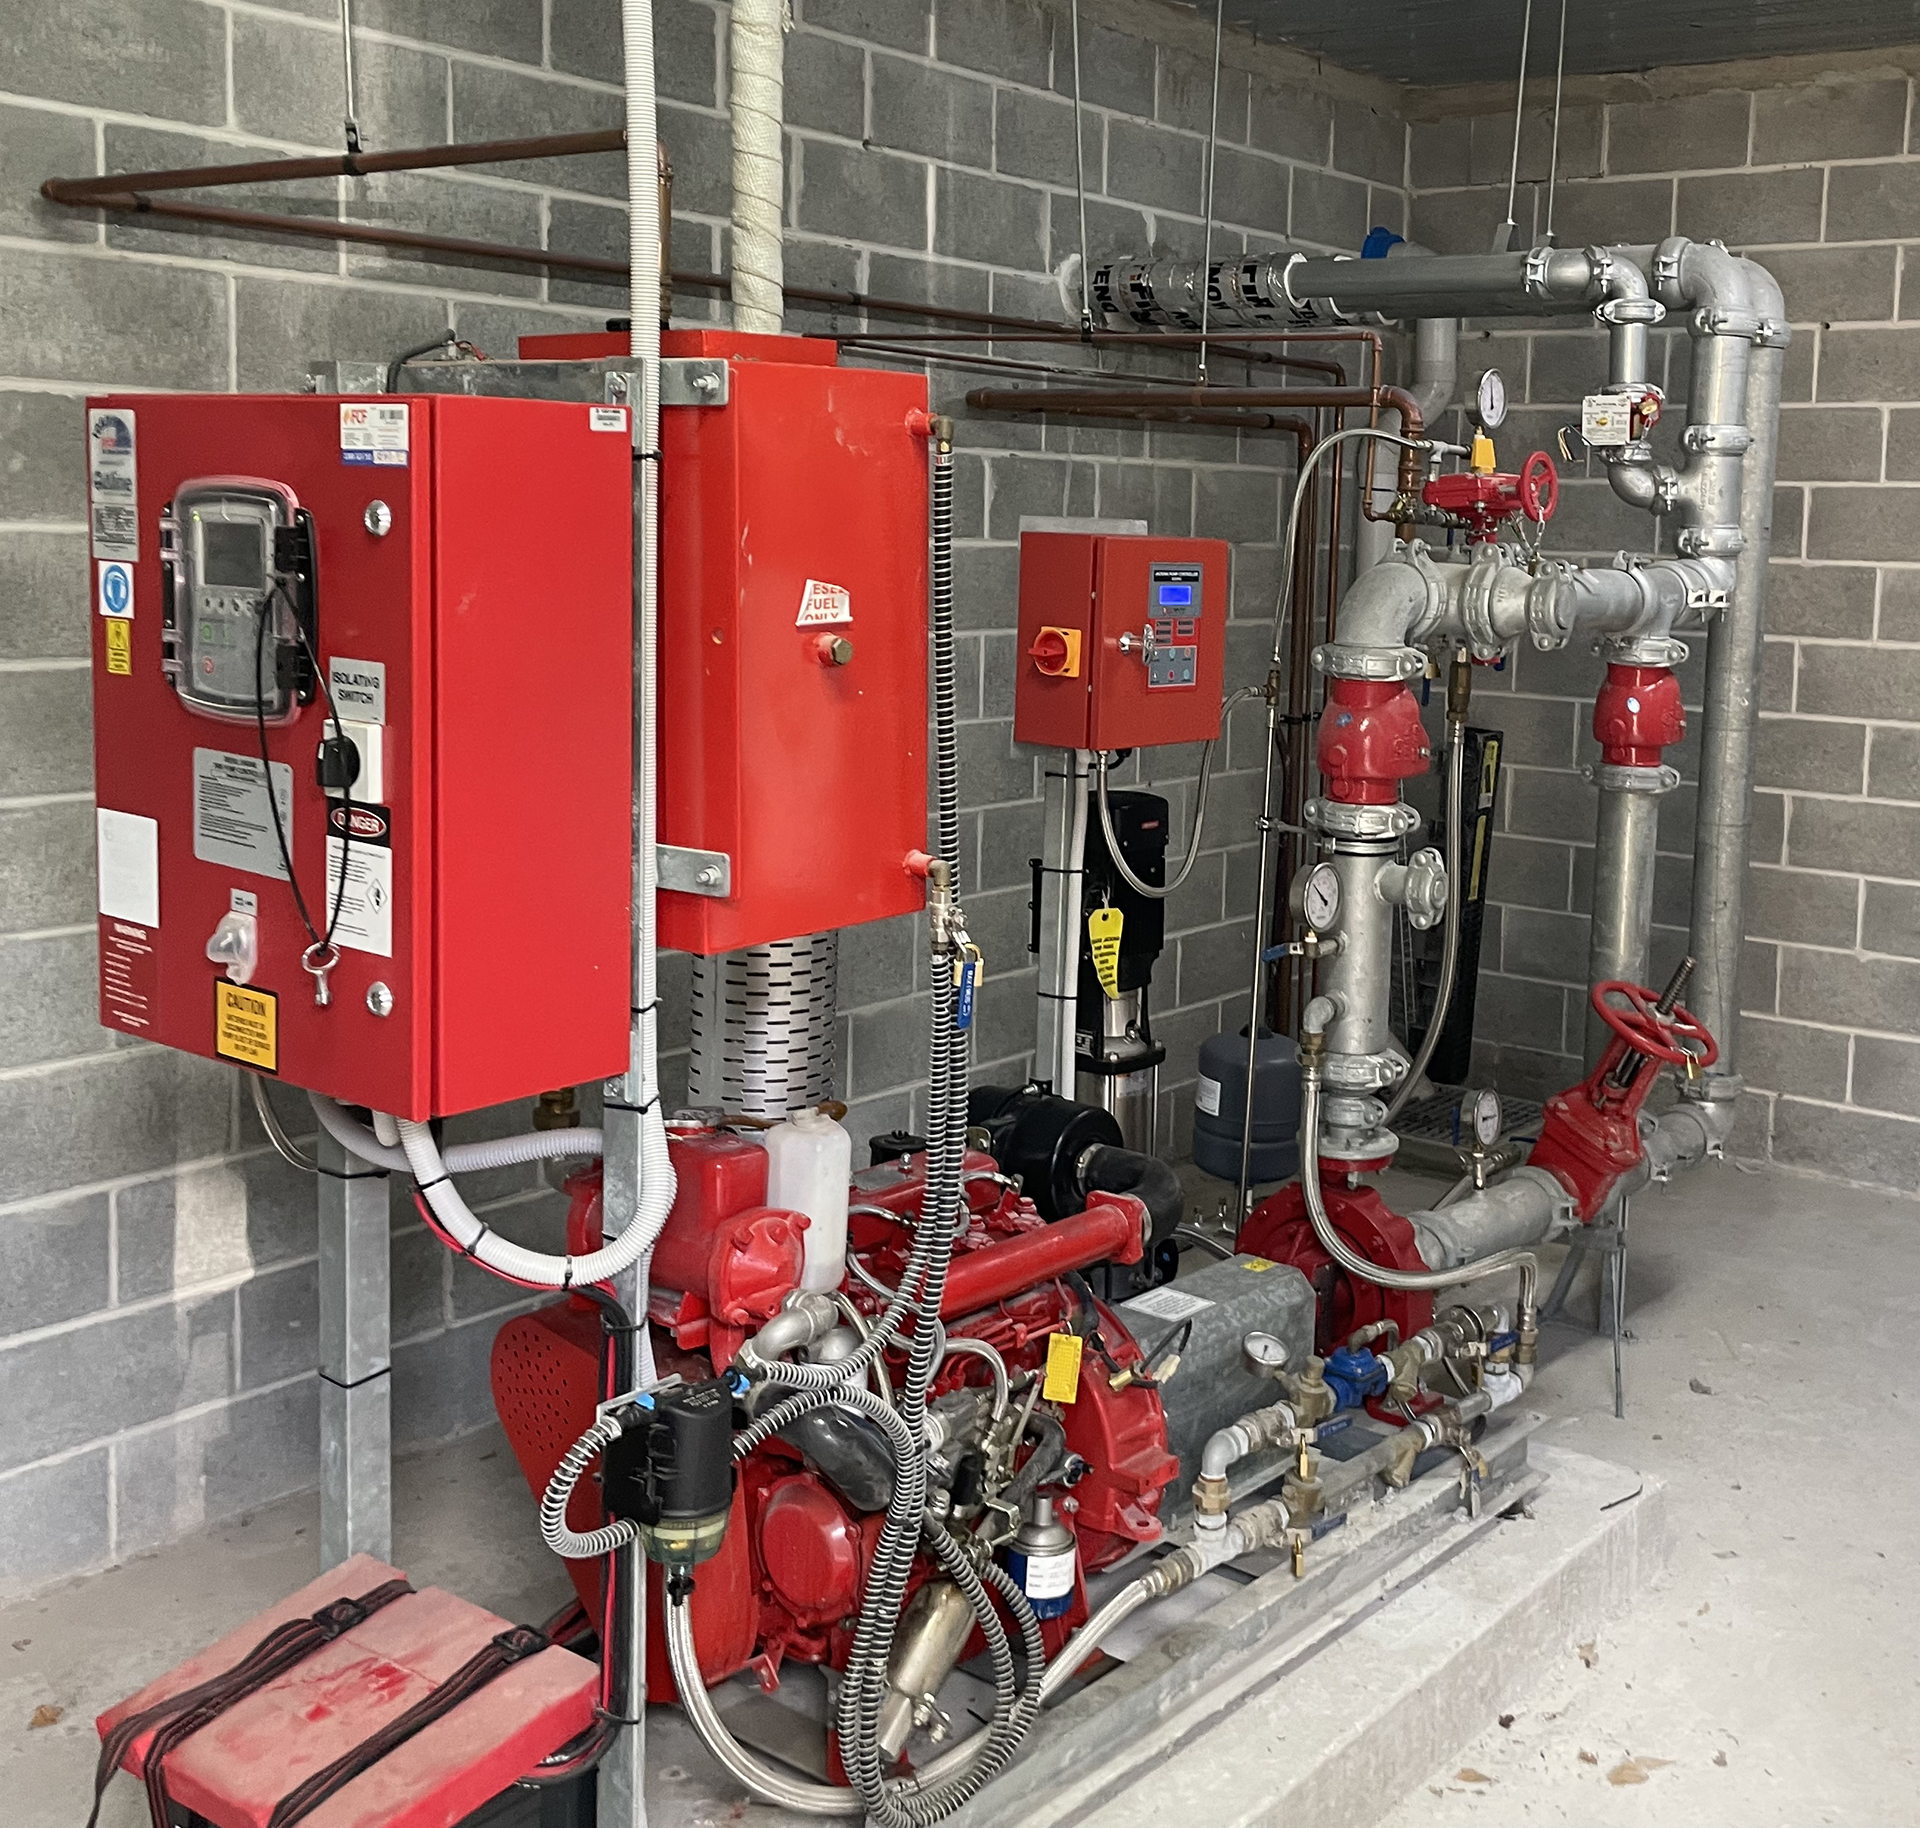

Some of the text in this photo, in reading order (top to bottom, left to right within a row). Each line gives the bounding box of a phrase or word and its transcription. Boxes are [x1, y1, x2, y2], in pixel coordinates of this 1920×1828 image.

[806, 597, 839, 611] FUEL
[332, 671, 380, 689] ISOLATING
[338, 689, 374, 705] SWITCH
[336, 811, 380, 833] DNGER
[226, 991, 267, 1017] CAUTION
